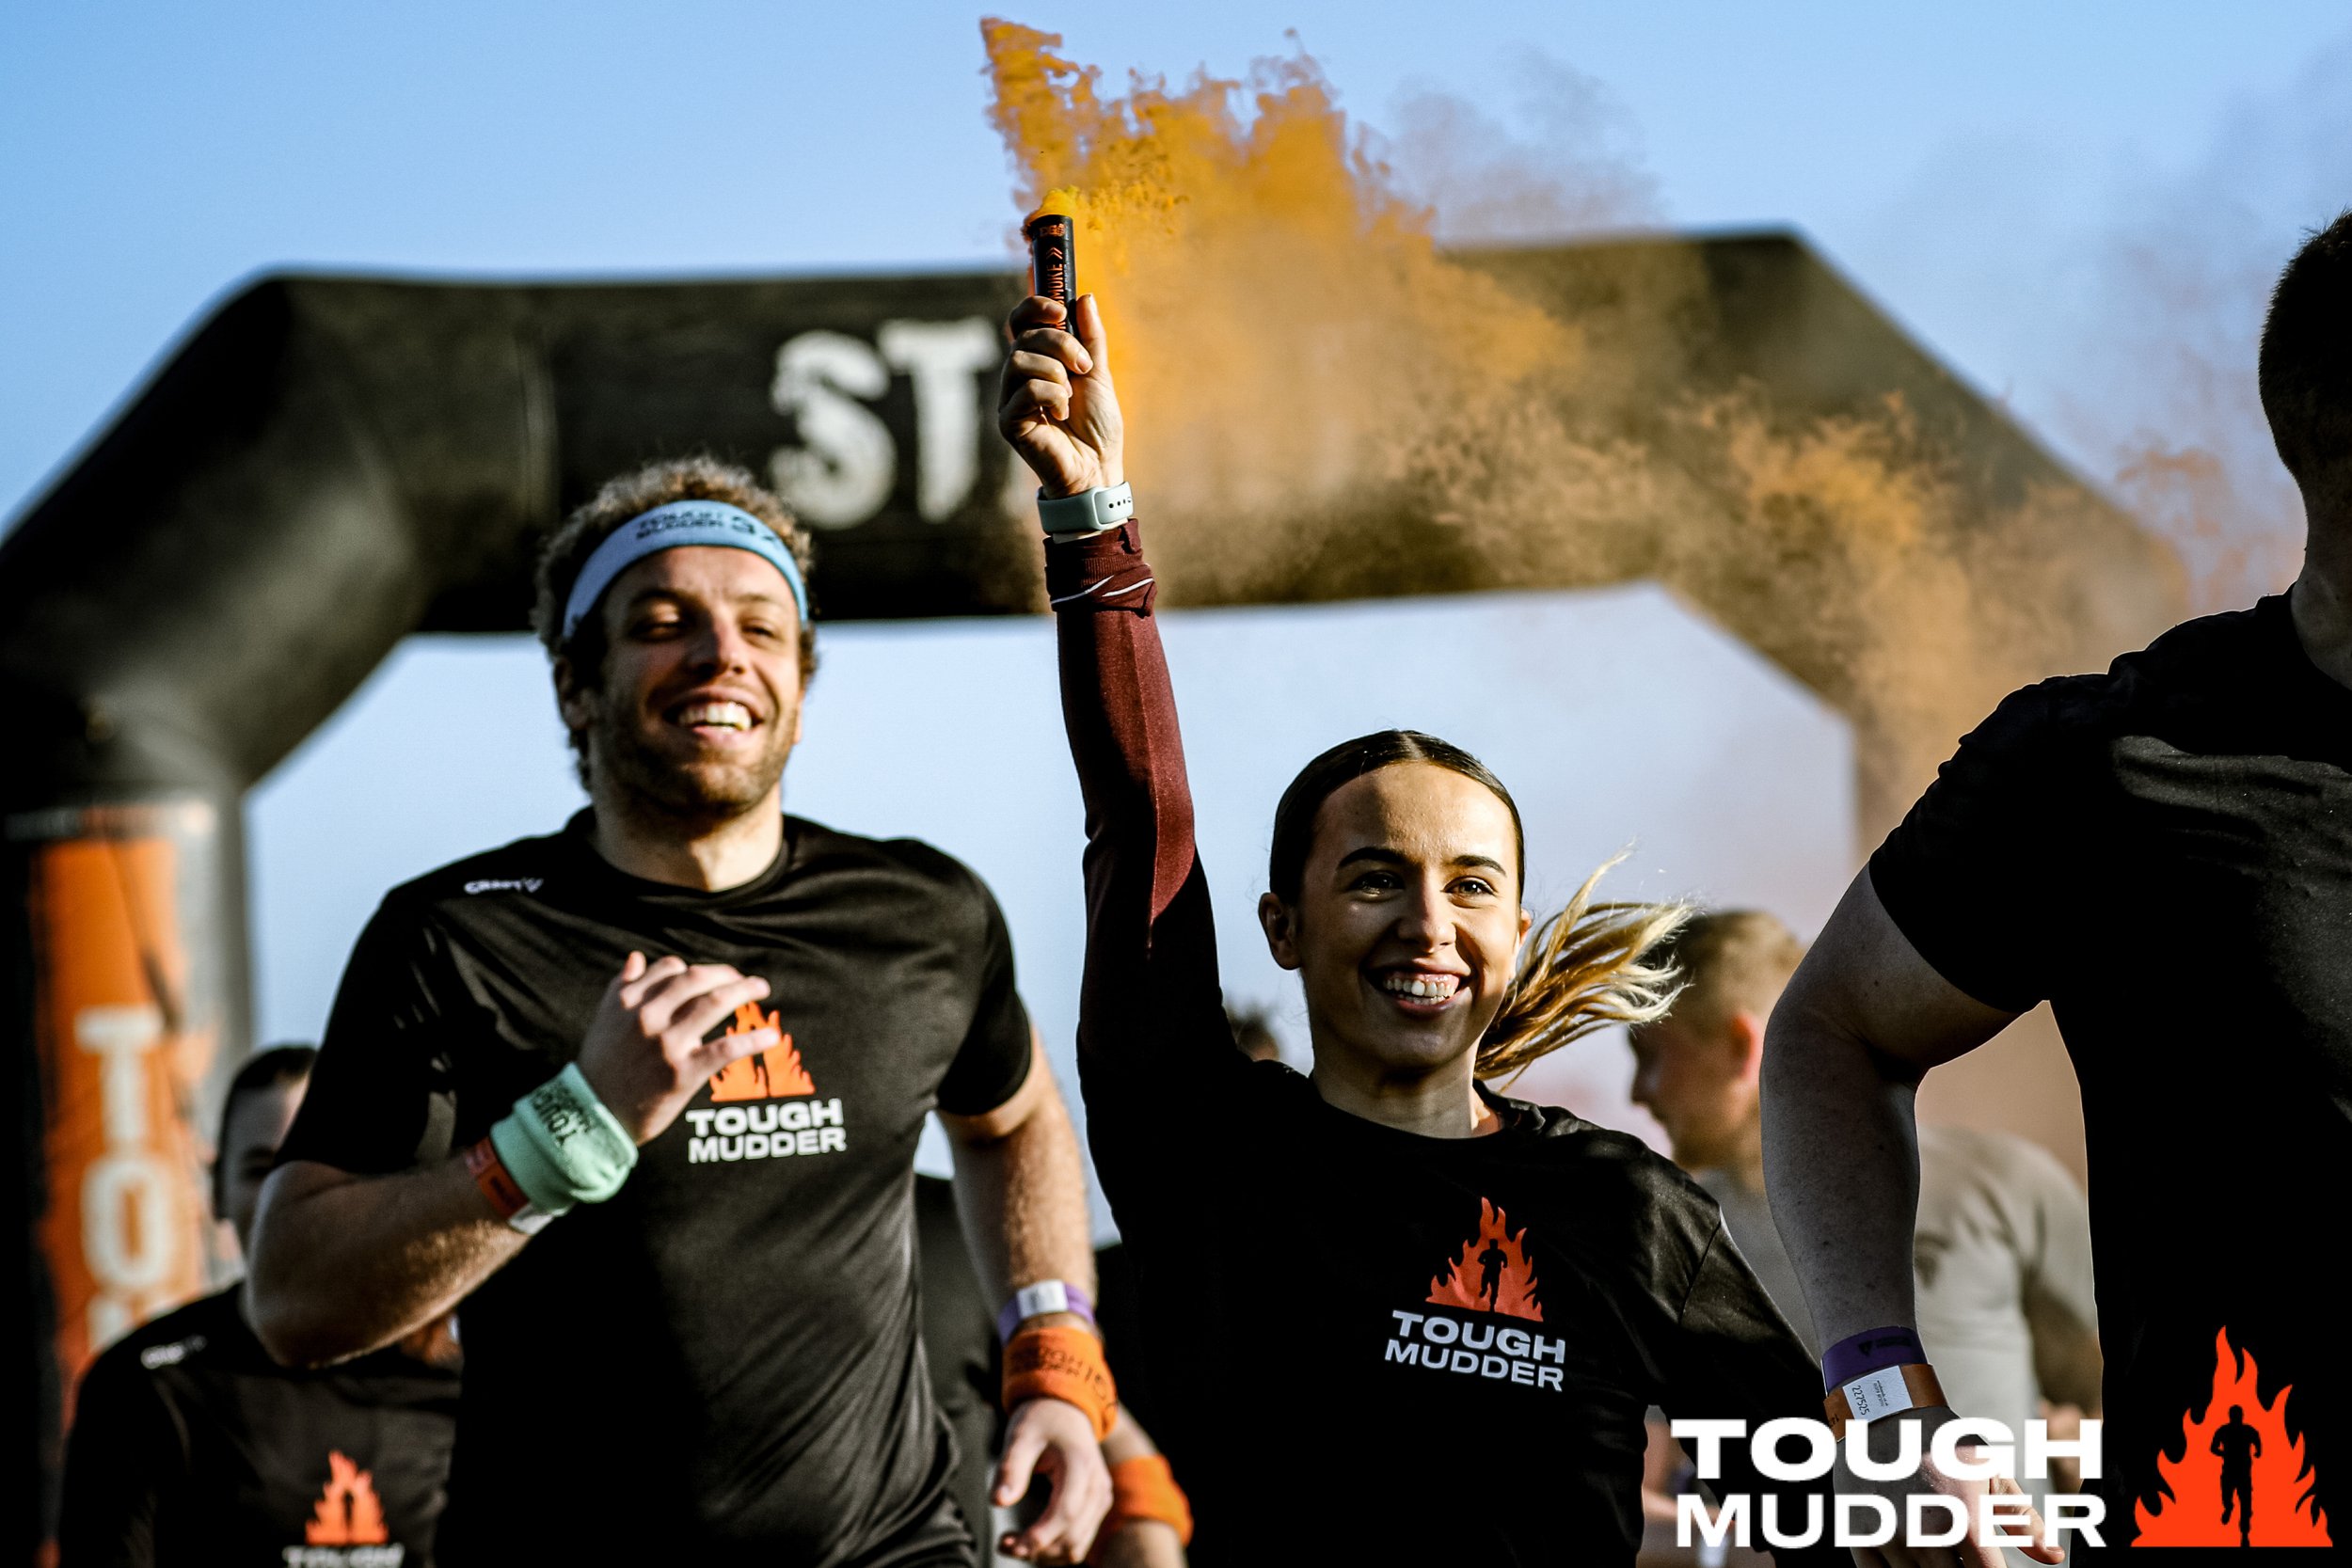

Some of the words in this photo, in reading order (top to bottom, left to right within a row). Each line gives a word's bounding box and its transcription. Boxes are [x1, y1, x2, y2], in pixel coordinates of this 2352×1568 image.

[685, 1098, 844, 1137] TOUGH
[687, 1126, 847, 1164] MUDDER
[76, 1006, 177, 1349] TO
[1392, 1309, 1566, 1364] TOUGH
[1385, 1338, 1565, 1392] MUDDER
[1851, 1385, 1870, 1416] 227525
